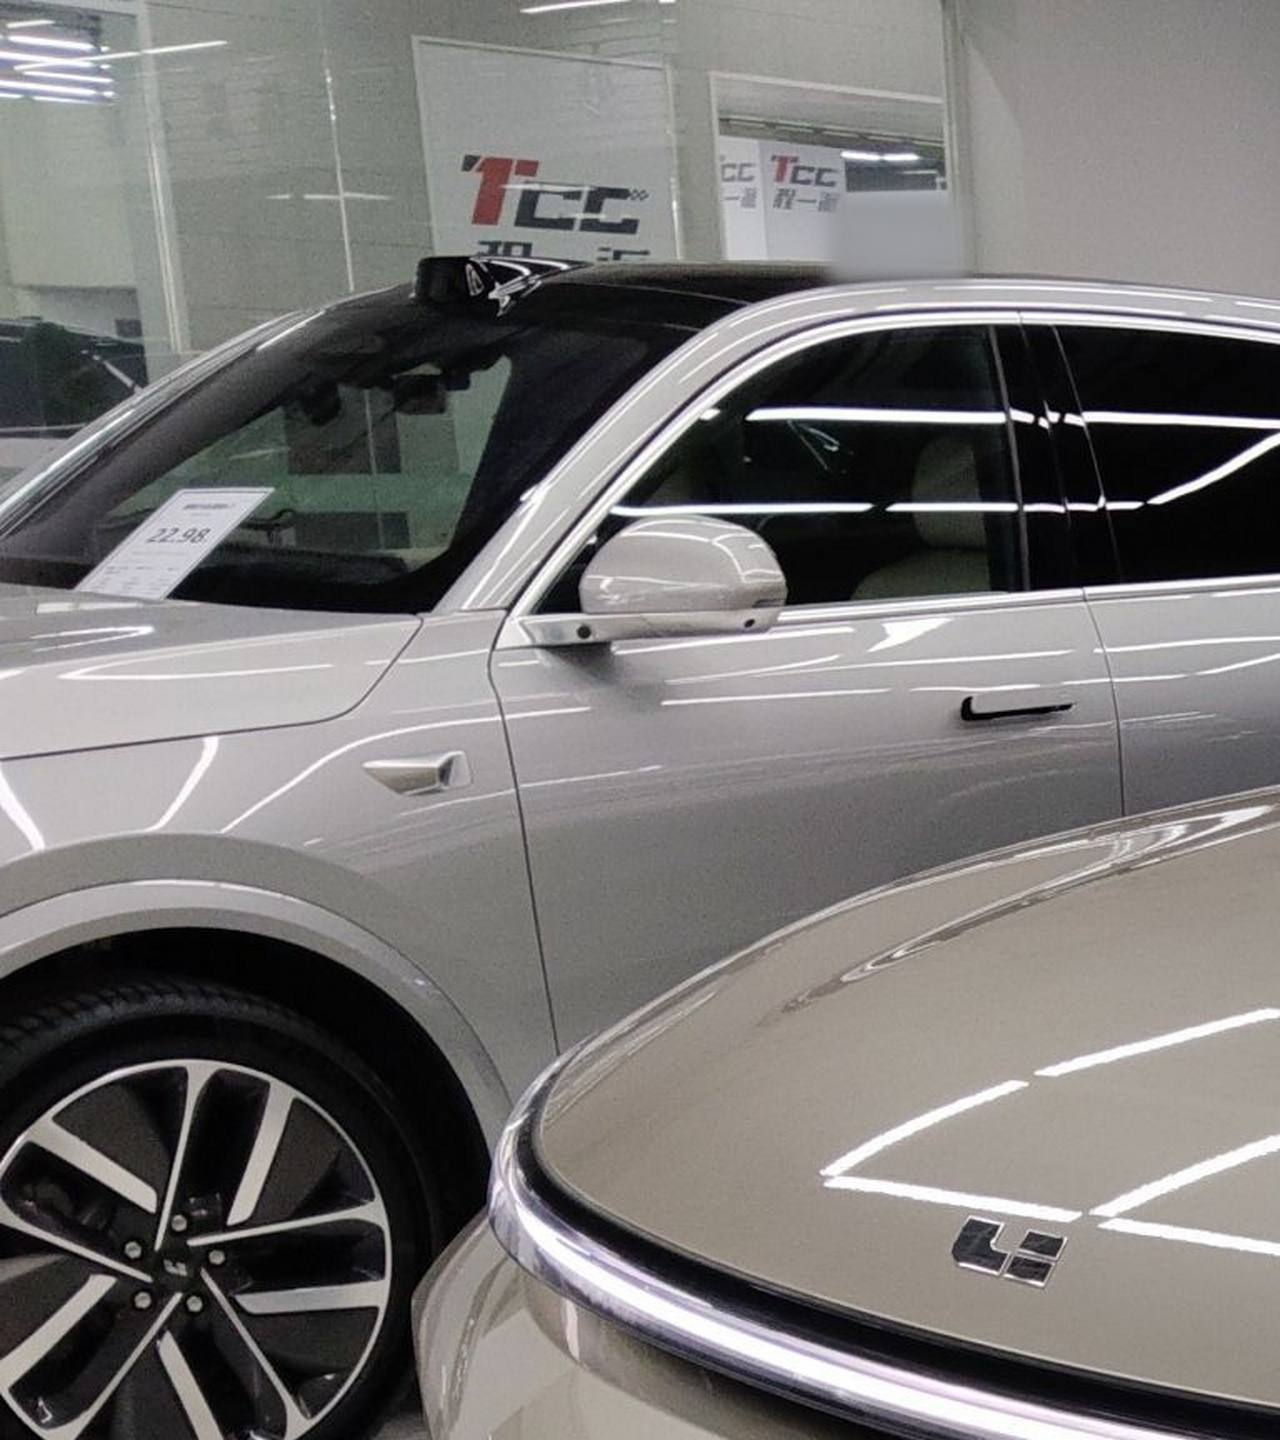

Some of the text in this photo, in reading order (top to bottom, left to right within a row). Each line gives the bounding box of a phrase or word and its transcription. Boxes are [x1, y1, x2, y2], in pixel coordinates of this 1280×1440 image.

[771, 154, 839, 187] TCC
[462, 154, 641, 235] TCC
[146, 527, 211, 544] 22.98
